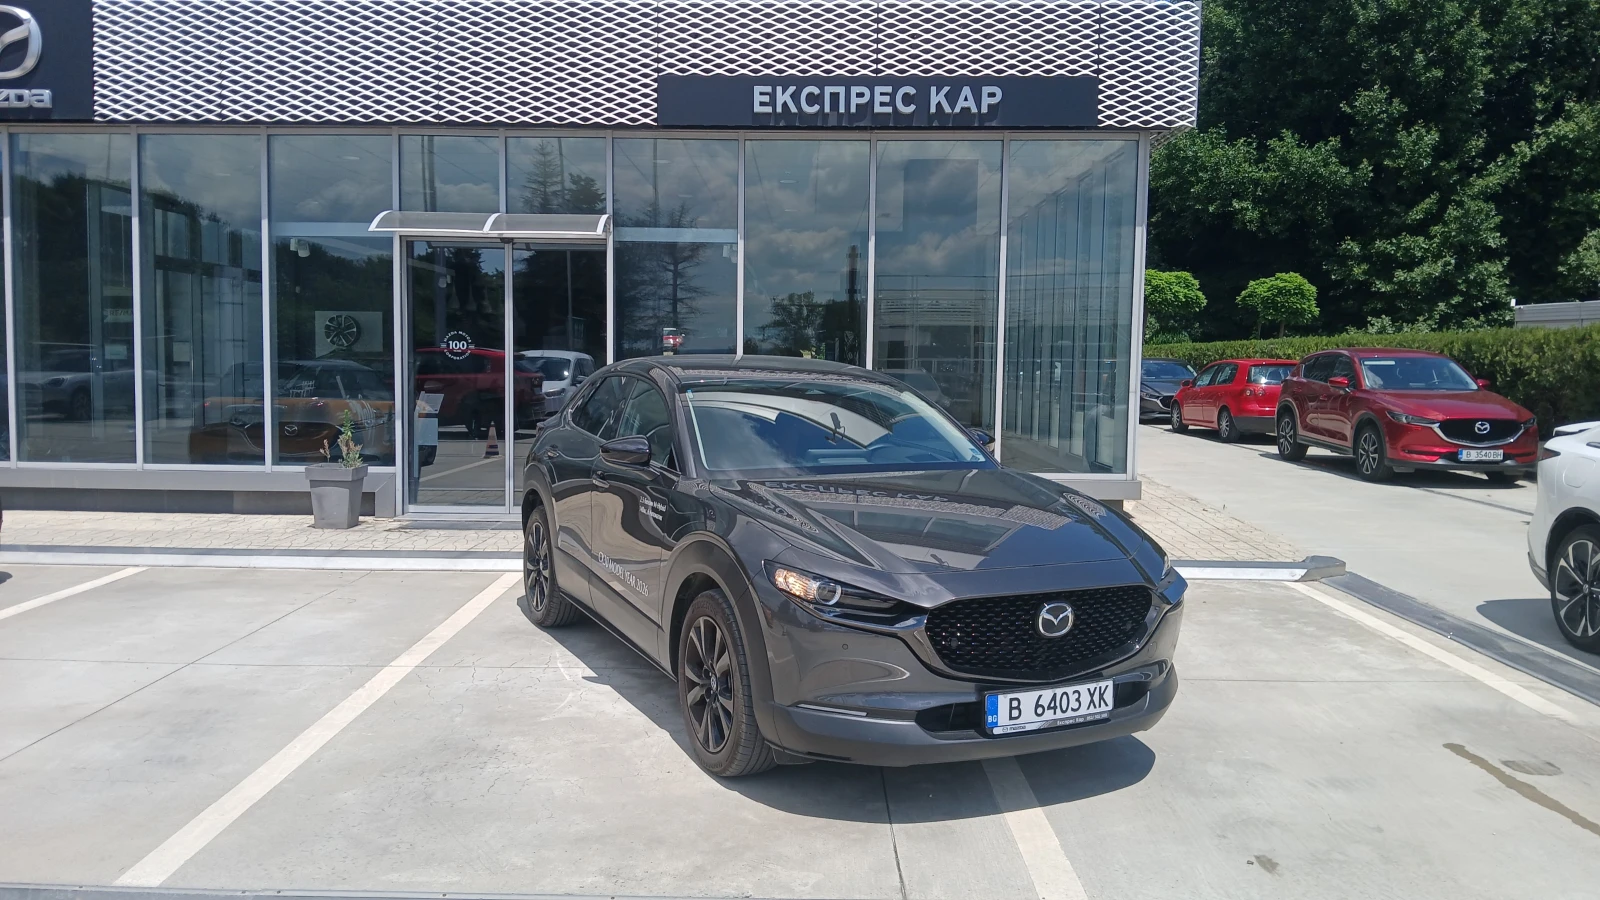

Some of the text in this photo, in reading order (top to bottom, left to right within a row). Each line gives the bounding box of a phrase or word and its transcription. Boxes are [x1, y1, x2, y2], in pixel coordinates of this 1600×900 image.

[753, 85, 1003, 115] ЕКСПРЕС КАР
[448, 341, 467, 349] 100
[608, 558, 624, 579] MODEL
[624, 569, 635, 588] YEAR
[636, 578, 649, 597] 2026
[1008, 685, 1110, 721] B 6403 XK
[987, 715, 998, 723] BG
